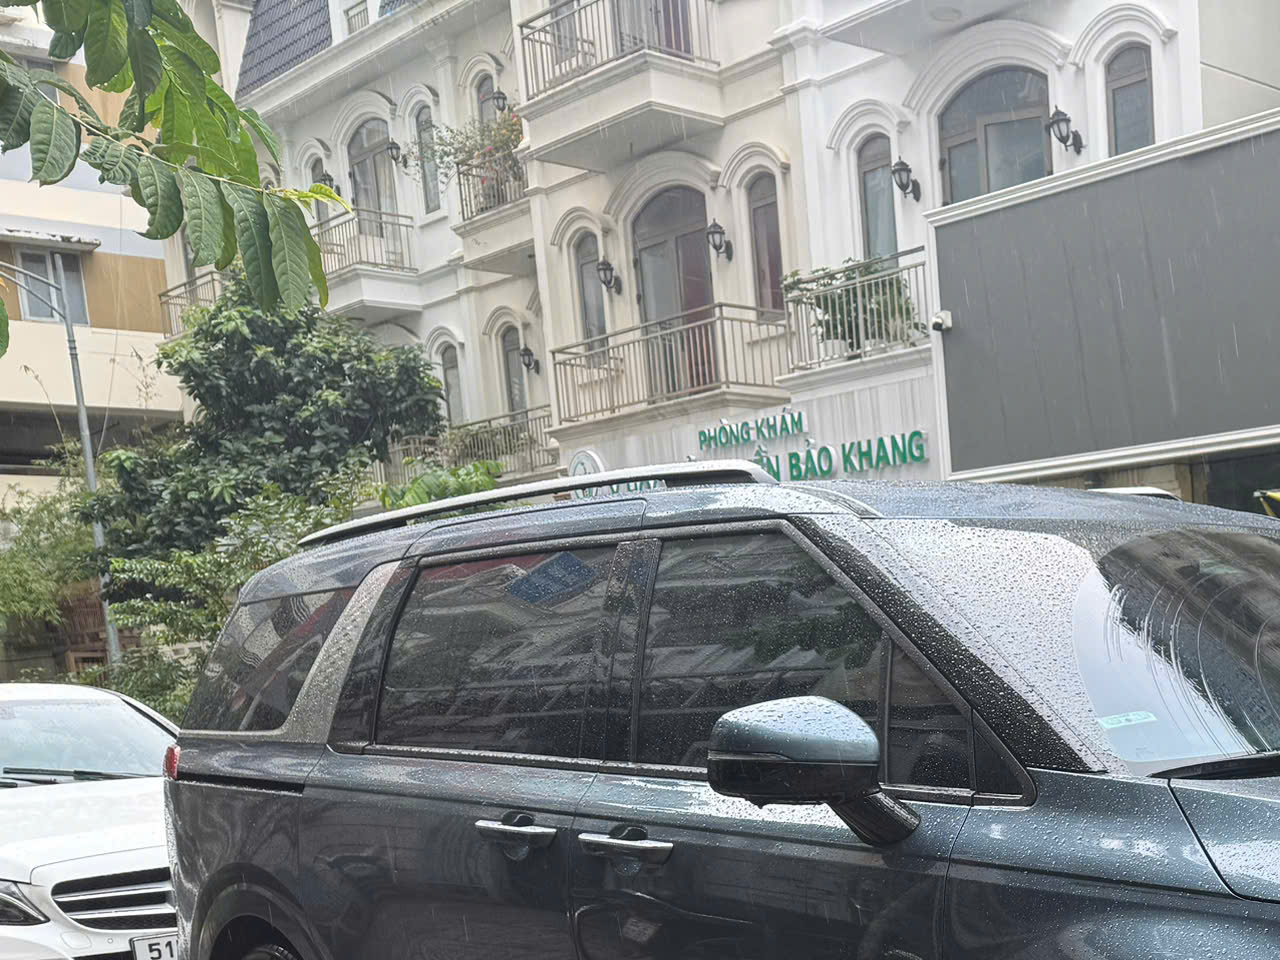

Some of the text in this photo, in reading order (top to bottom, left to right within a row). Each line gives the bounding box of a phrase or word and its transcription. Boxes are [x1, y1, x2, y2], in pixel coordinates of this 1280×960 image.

[698, 407, 804, 450] PHÒNG KHÁM
[788, 438, 833, 481] BẢO
[841, 430, 925, 473] KHANG
[147, 939, 178, 960] 51
